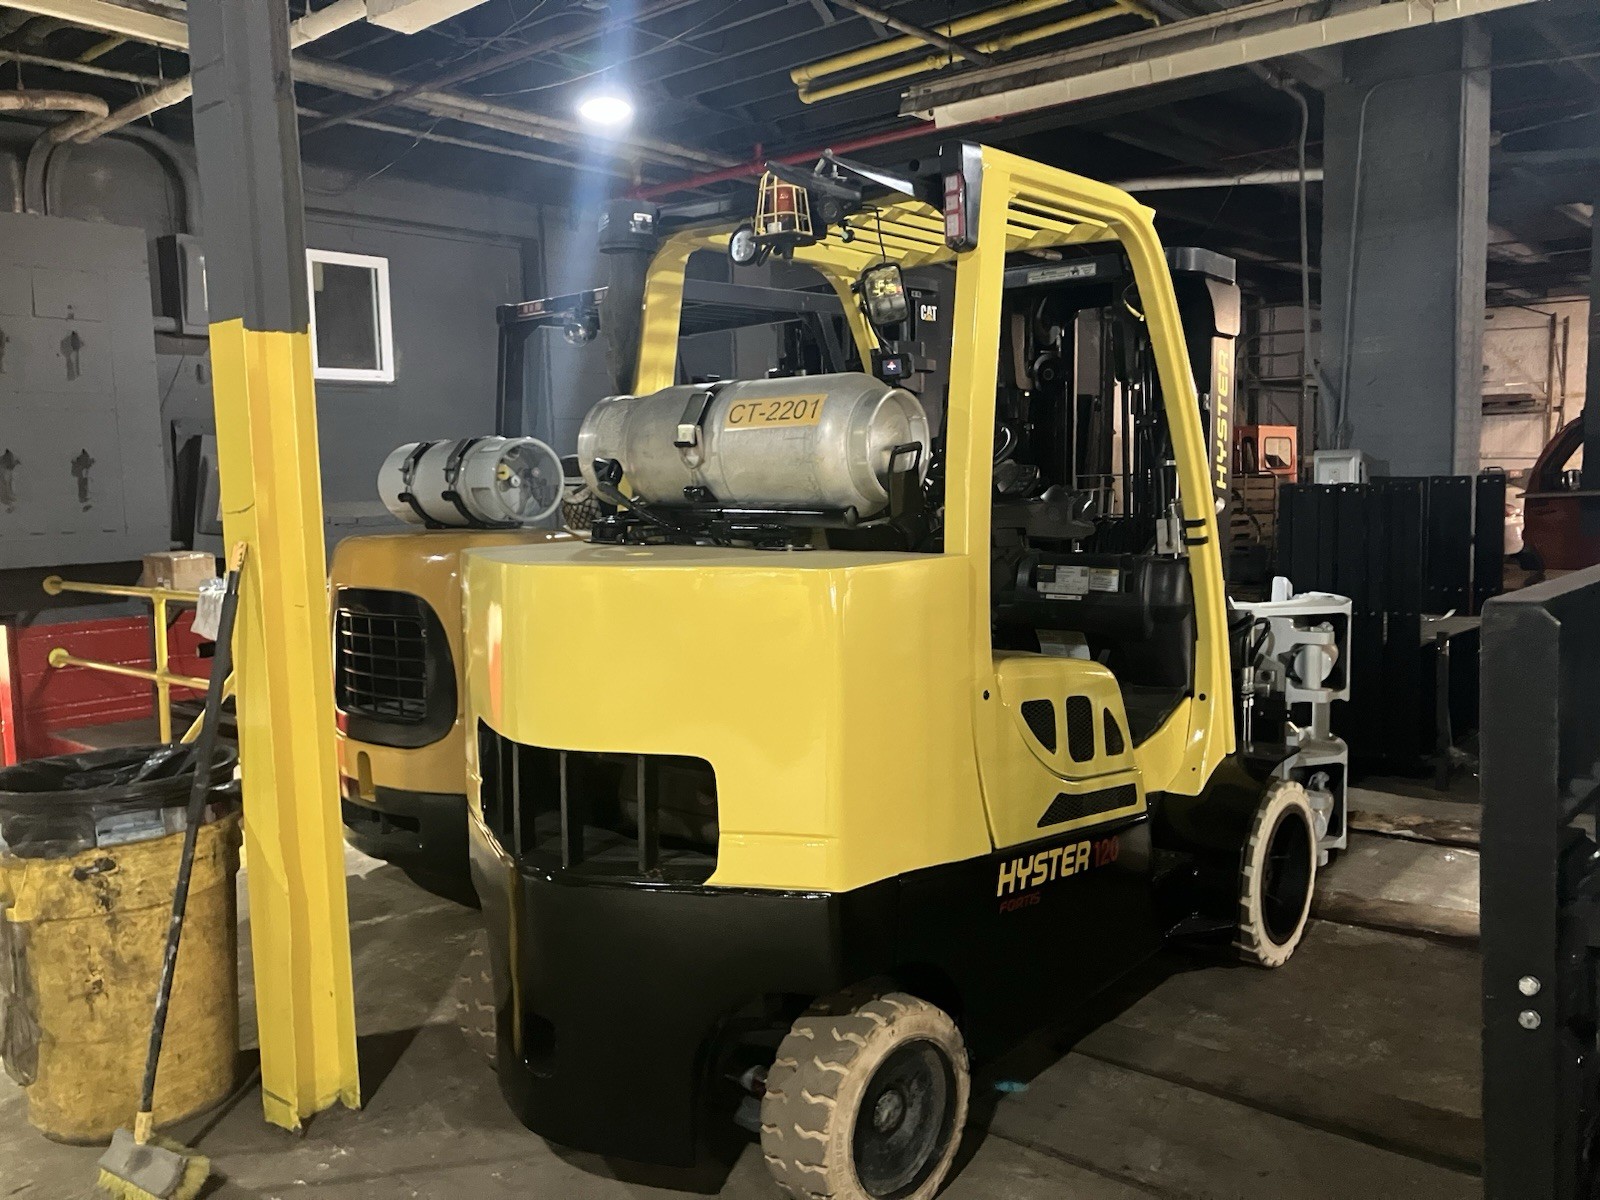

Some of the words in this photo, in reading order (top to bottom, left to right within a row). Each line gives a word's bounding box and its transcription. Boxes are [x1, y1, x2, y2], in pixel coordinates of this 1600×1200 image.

[920, 304, 938, 321] CAT
[729, 399, 820, 424] CT-2201
[1216, 349, 1229, 490] HYSTER
[997, 840, 1091, 897] HYSTER
[1094, 835, 1120, 868] 120
[1000, 892, 1041, 914] FORTIS
